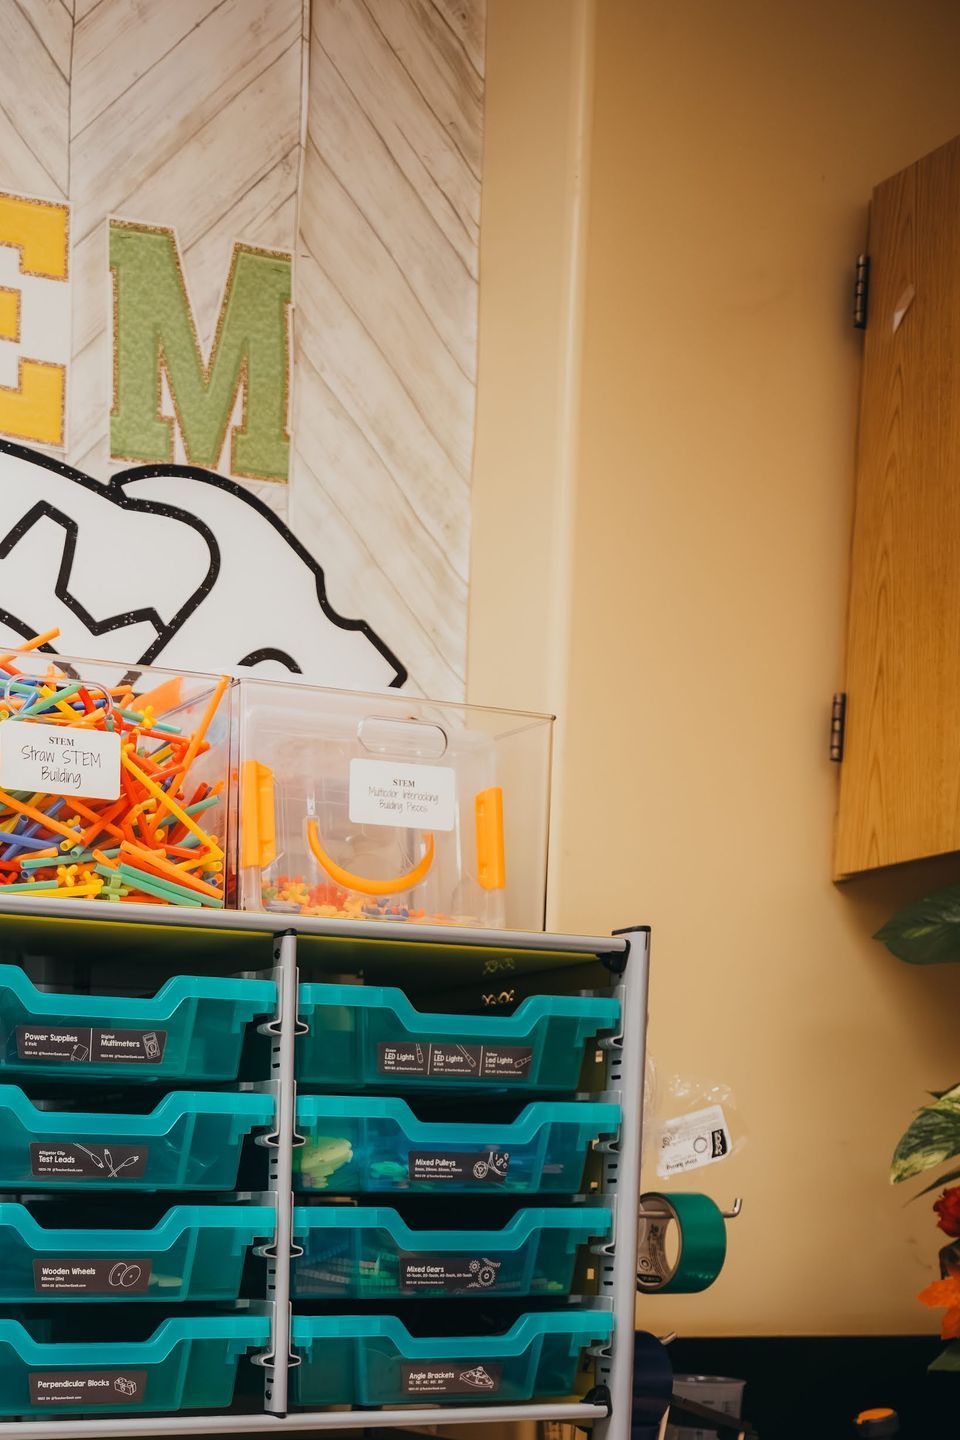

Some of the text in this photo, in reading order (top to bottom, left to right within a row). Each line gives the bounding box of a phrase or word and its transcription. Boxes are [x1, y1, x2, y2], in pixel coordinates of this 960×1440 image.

[49, 736, 74, 746] STEM
[21, 745, 102, 768] Straw STEM
[41, 766, 82, 789] Building
[393, 779, 415, 787] STEM
[379, 799, 403, 813] Building
[24, 1032, 78, 1043] Power Supplies
[101, 1039, 140, 1047] Multimeters
[385, 1052, 415, 1061] LED Lights
[434, 1054, 463, 1063] LED Lights
[39, 1155, 53, 1163] Test
[435, 1159, 456, 1167] Pulleys
[42, 1267, 70, 1275] Wooden
[37, 1380, 86, 1389] Perpendicular
